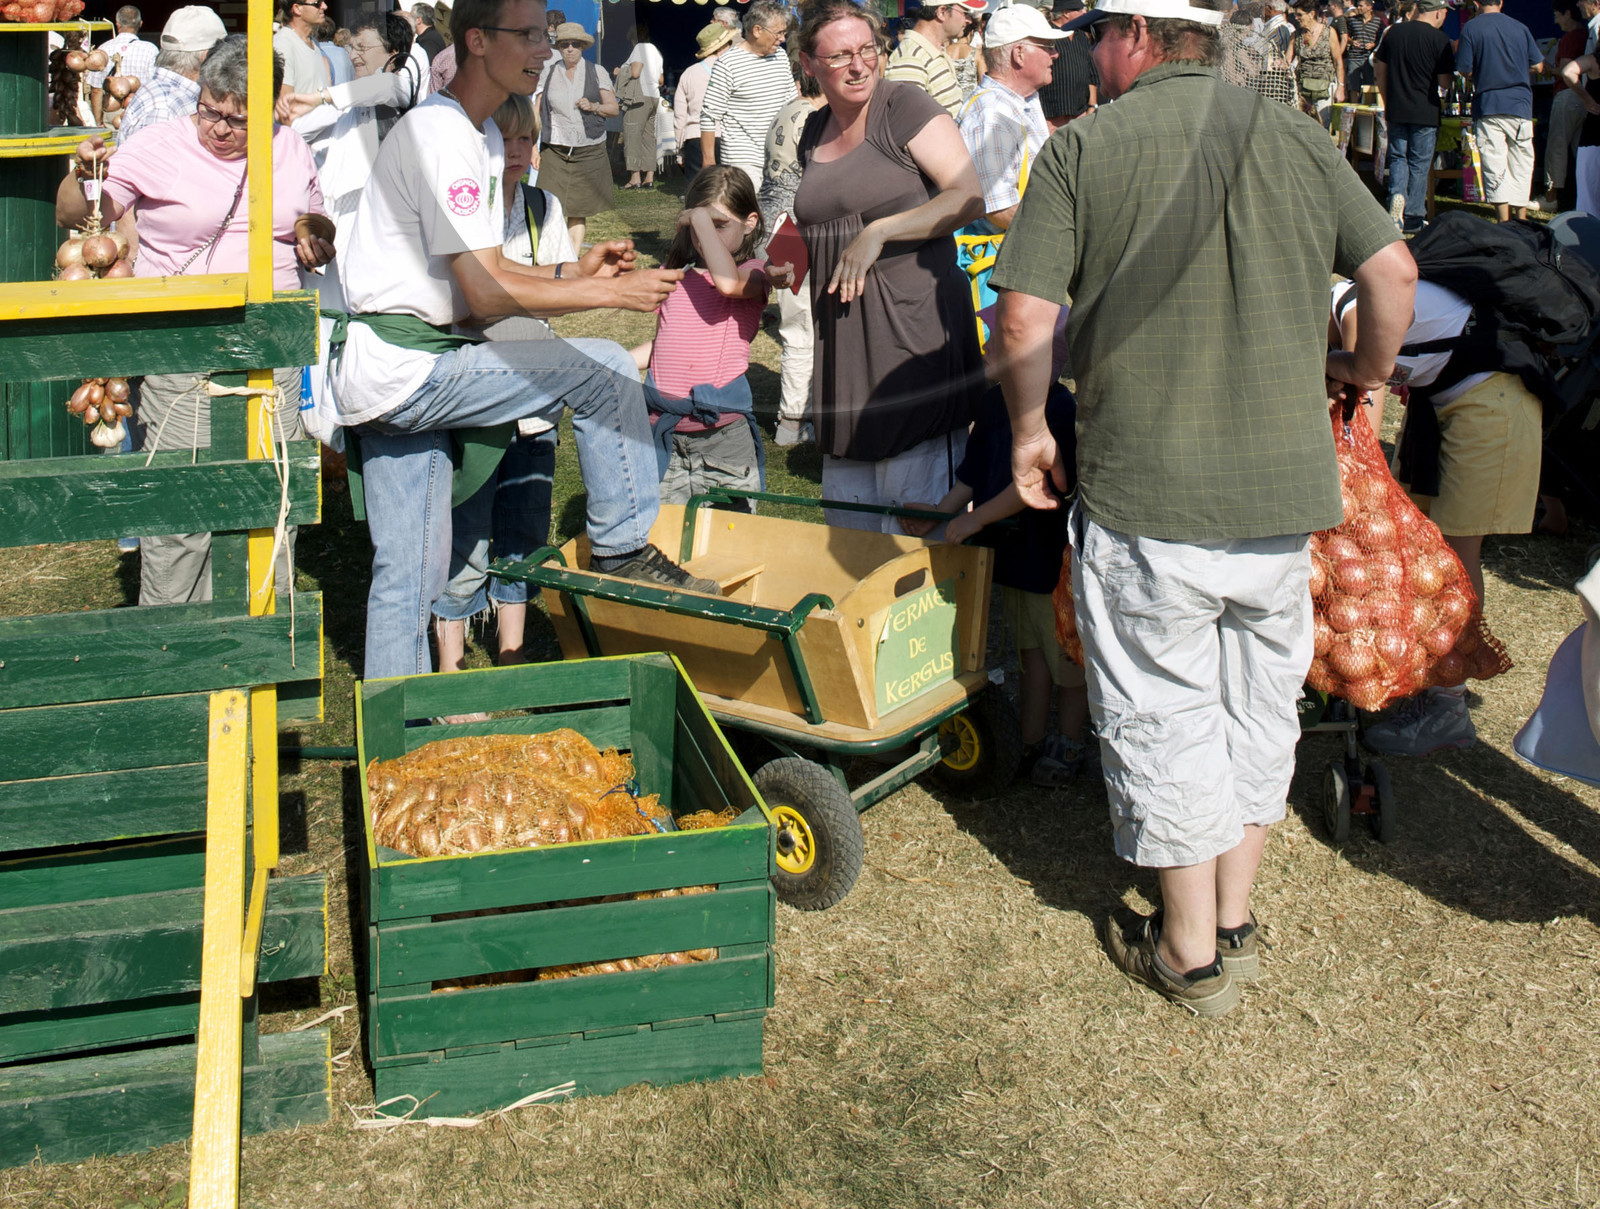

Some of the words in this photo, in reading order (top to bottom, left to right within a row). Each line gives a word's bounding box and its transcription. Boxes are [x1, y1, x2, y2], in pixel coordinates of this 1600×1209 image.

[889, 588, 946, 632] ERME
[908, 636, 927, 659] DE
[885, 653, 953, 704] KERGUS
